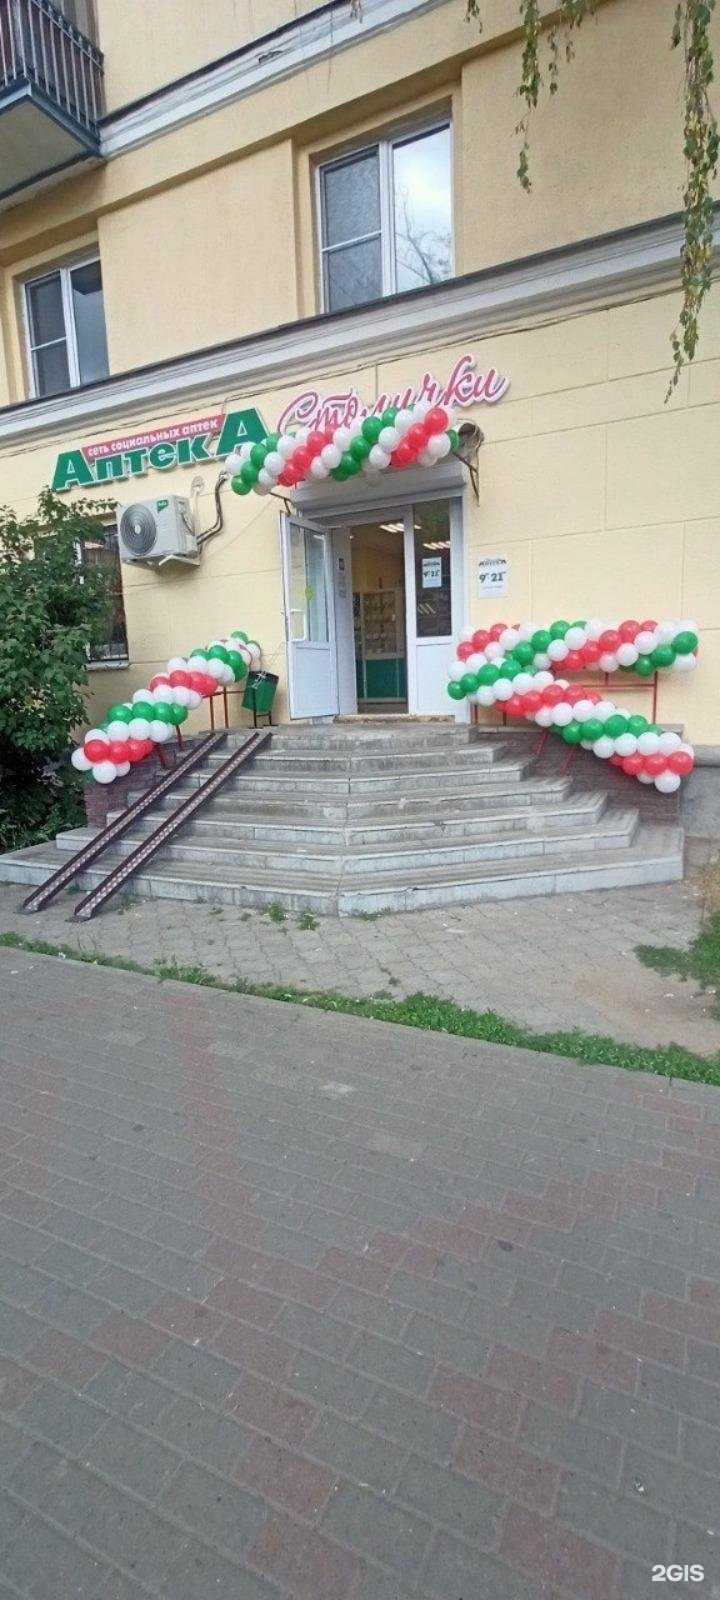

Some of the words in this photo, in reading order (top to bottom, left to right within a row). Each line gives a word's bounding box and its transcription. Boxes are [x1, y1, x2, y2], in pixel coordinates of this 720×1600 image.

[88, 444, 109, 458] сеть
[111, 427, 180, 452] социальных
[181, 419, 218, 436] аптек
